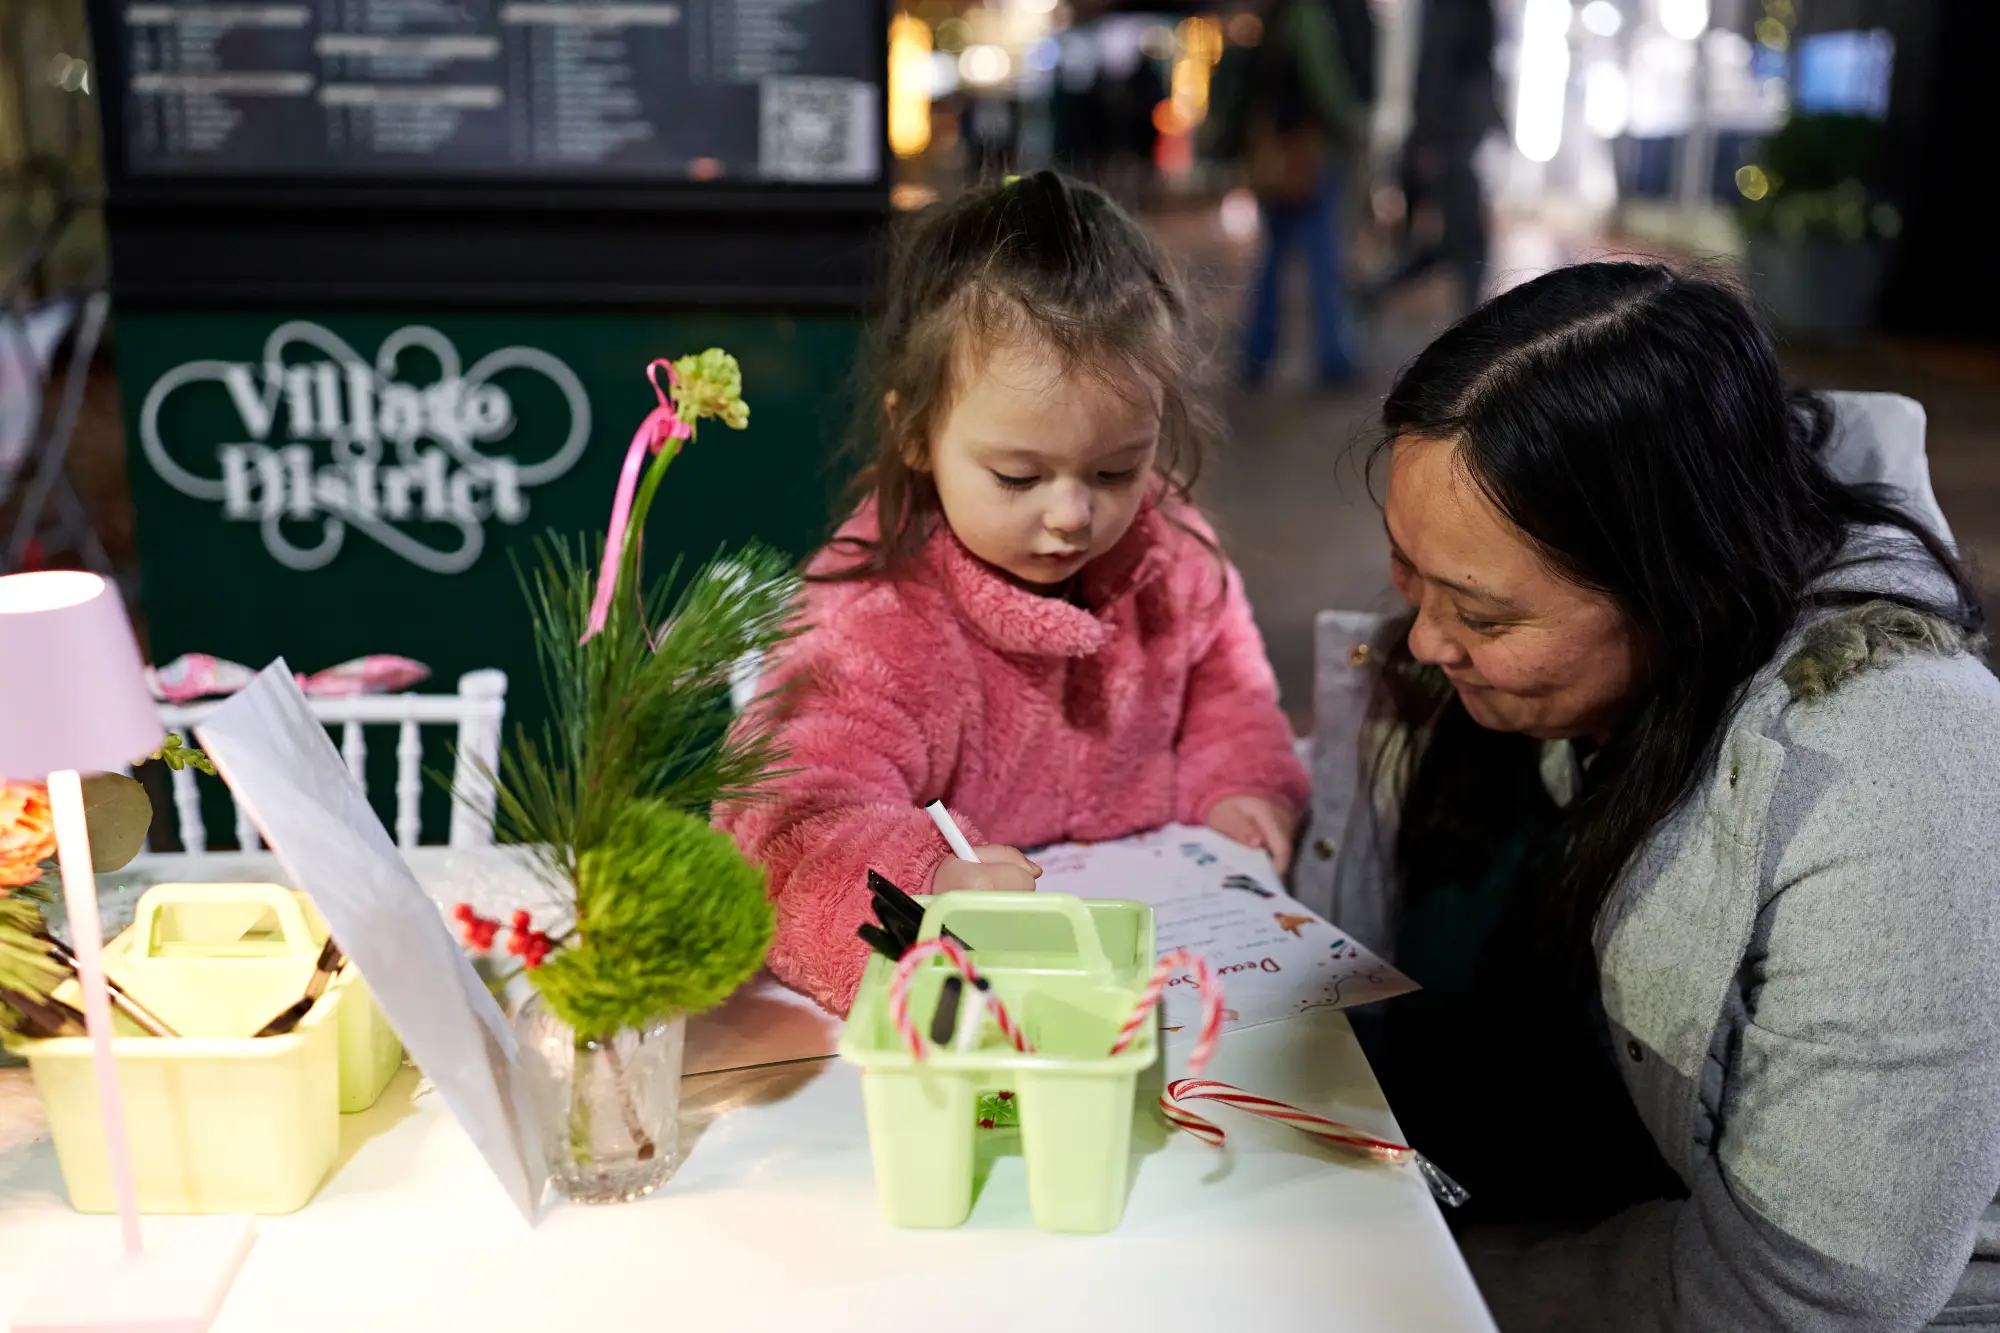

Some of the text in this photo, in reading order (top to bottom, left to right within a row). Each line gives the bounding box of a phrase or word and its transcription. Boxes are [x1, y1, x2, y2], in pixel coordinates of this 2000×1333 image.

[222, 361, 513, 441] Village
[218, 443, 529, 524] District
[1217, 957, 1281, 976] Dear
